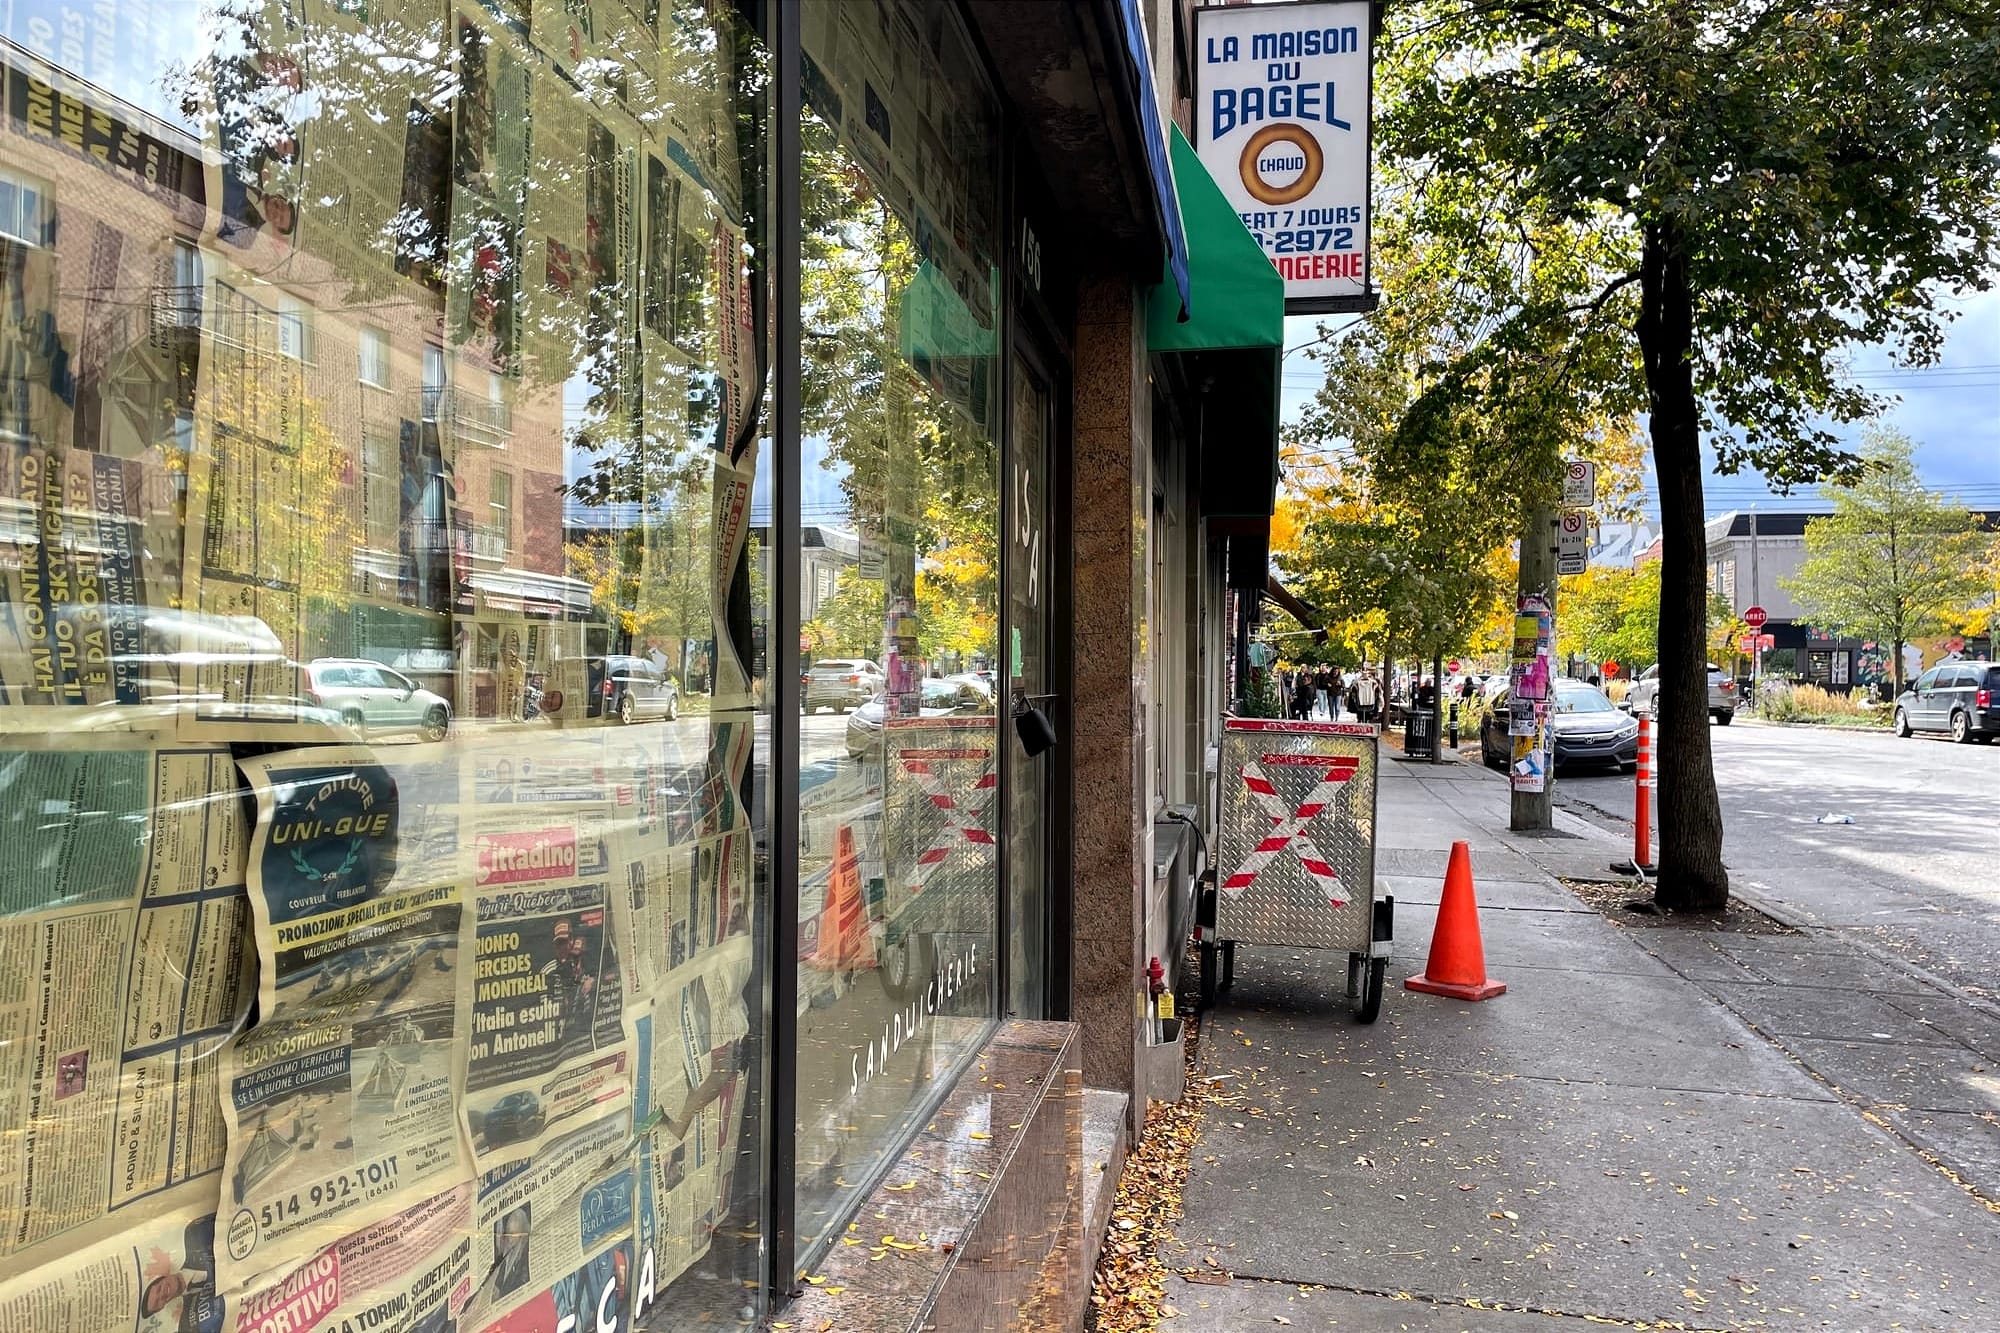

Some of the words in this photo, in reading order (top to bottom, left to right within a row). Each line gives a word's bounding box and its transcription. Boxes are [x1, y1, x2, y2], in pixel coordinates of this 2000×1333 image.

[1207, 36, 1239, 63] LA
[1252, 27, 1357, 60] MAISON
[1267, 62, 1300, 83] DU
[1213, 82, 1351, 141] BAGEL
[1260, 157, 1304, 172] CHAUD
[1239, 211, 1278, 229] ERT
[1283, 210, 1294, 227] 7
[1297, 206, 1361, 227] JOURS
[55, 619, 79, 672] TUO
[84, 630, 106, 664] DA
[30, 647, 56, 693] HAI
[273, 813, 389, 845] UNI-QUE
[477, 836, 573, 884] Cittadino
[289, 893, 328, 911] COUVREUR
[278, 914, 346, 945] PROMOZIONE
[347, 905, 376, 926] SPECIALE
[377, 902, 392, 917] PER
[478, 970, 548, 1003] MONTRÉAL
[519, 997, 560, 1025] esulta
[851, 943, 976, 1095] SANDWICHERIE
[251, 1044, 268, 1066] DA
[272, 1024, 343, 1059] SOSTITUIRE?
[493, 1019, 556, 1056] Antonelli
[256, 1061, 298, 1084] POSSIAMO
[300, 1047, 345, 1069] VERIFICARE
[131, 1066, 147, 1123] SILICANI
[265, 1076, 293, 1095] BUONE
[130, 1125, 141, 1136] &
[125, 1139, 140, 1191] RADINO
[261, 1194, 301, 1229] 514
[310, 1154, 399, 1207] 952-TOIT
[498, 1187, 523, 1213] Mirella
[338, 1235, 366, 1256] Questa
[340, 1235, 399, 1266] Inter-Juventus
[411, 1252, 451, 1302] SCUDETTO
[413, 1281, 449, 1322] perdono
